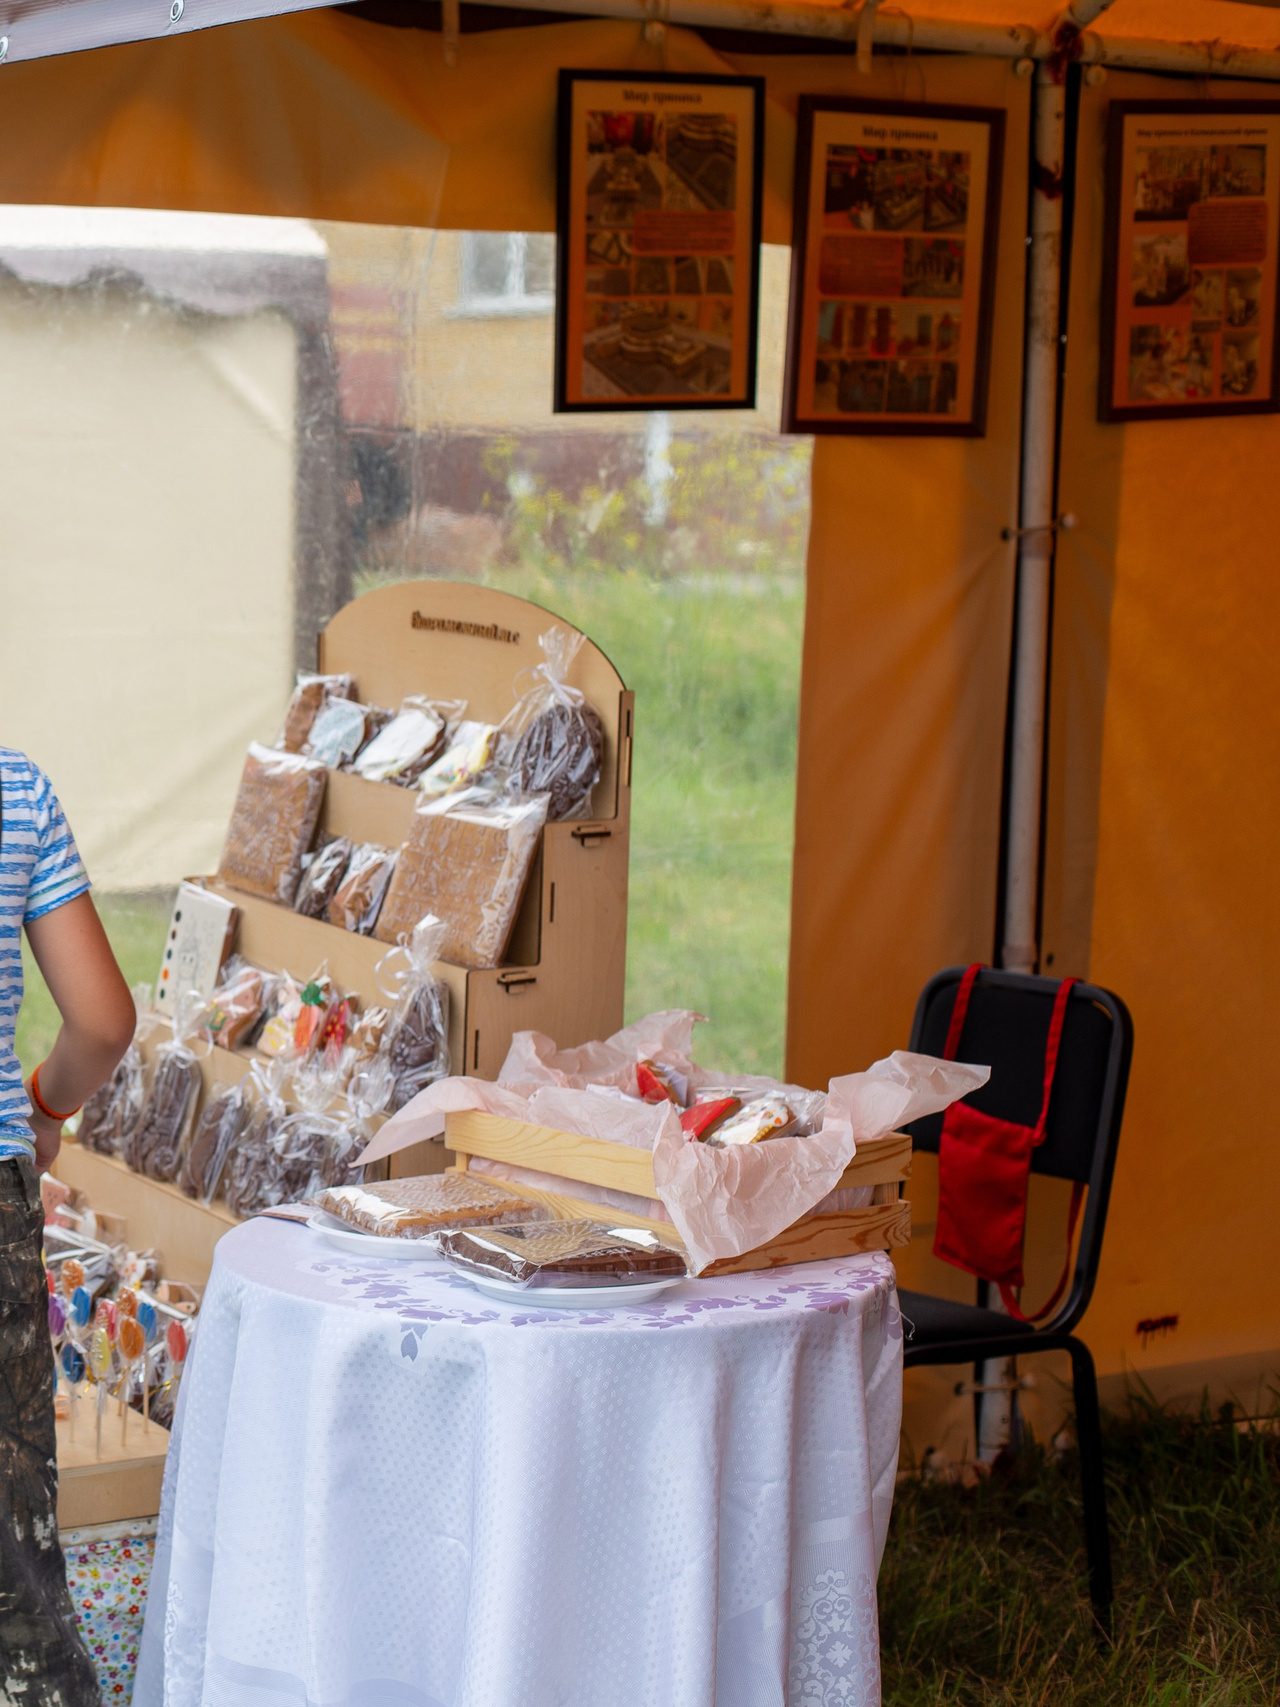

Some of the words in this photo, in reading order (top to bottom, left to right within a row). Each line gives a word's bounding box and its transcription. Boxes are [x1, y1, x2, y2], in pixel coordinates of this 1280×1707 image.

[623, 89, 650, 105] Мир
[652, 91, 703, 105] пряника
[862, 125, 887, 141] Мир
[889, 127, 939, 142] пряника
